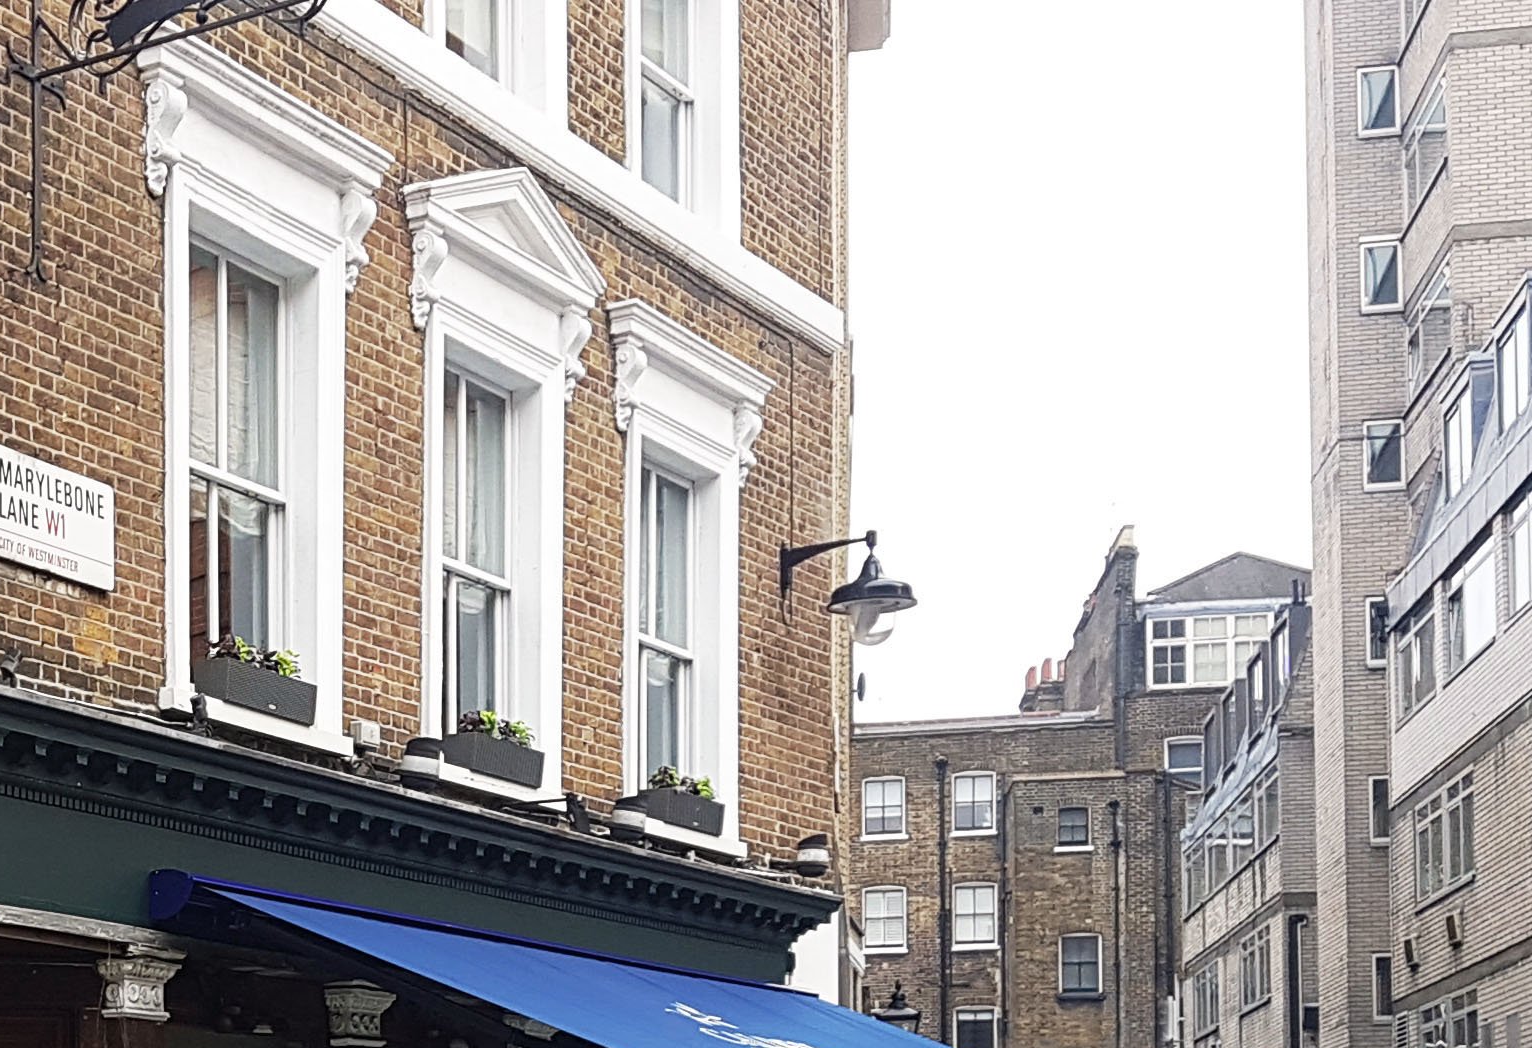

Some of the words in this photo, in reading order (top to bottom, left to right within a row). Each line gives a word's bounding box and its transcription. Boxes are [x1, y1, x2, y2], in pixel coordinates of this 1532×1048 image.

[45, 510, 66, 540] W1
[16, 541, 26, 555] OF
[27, 543, 79, 573] WESTMINSTER
